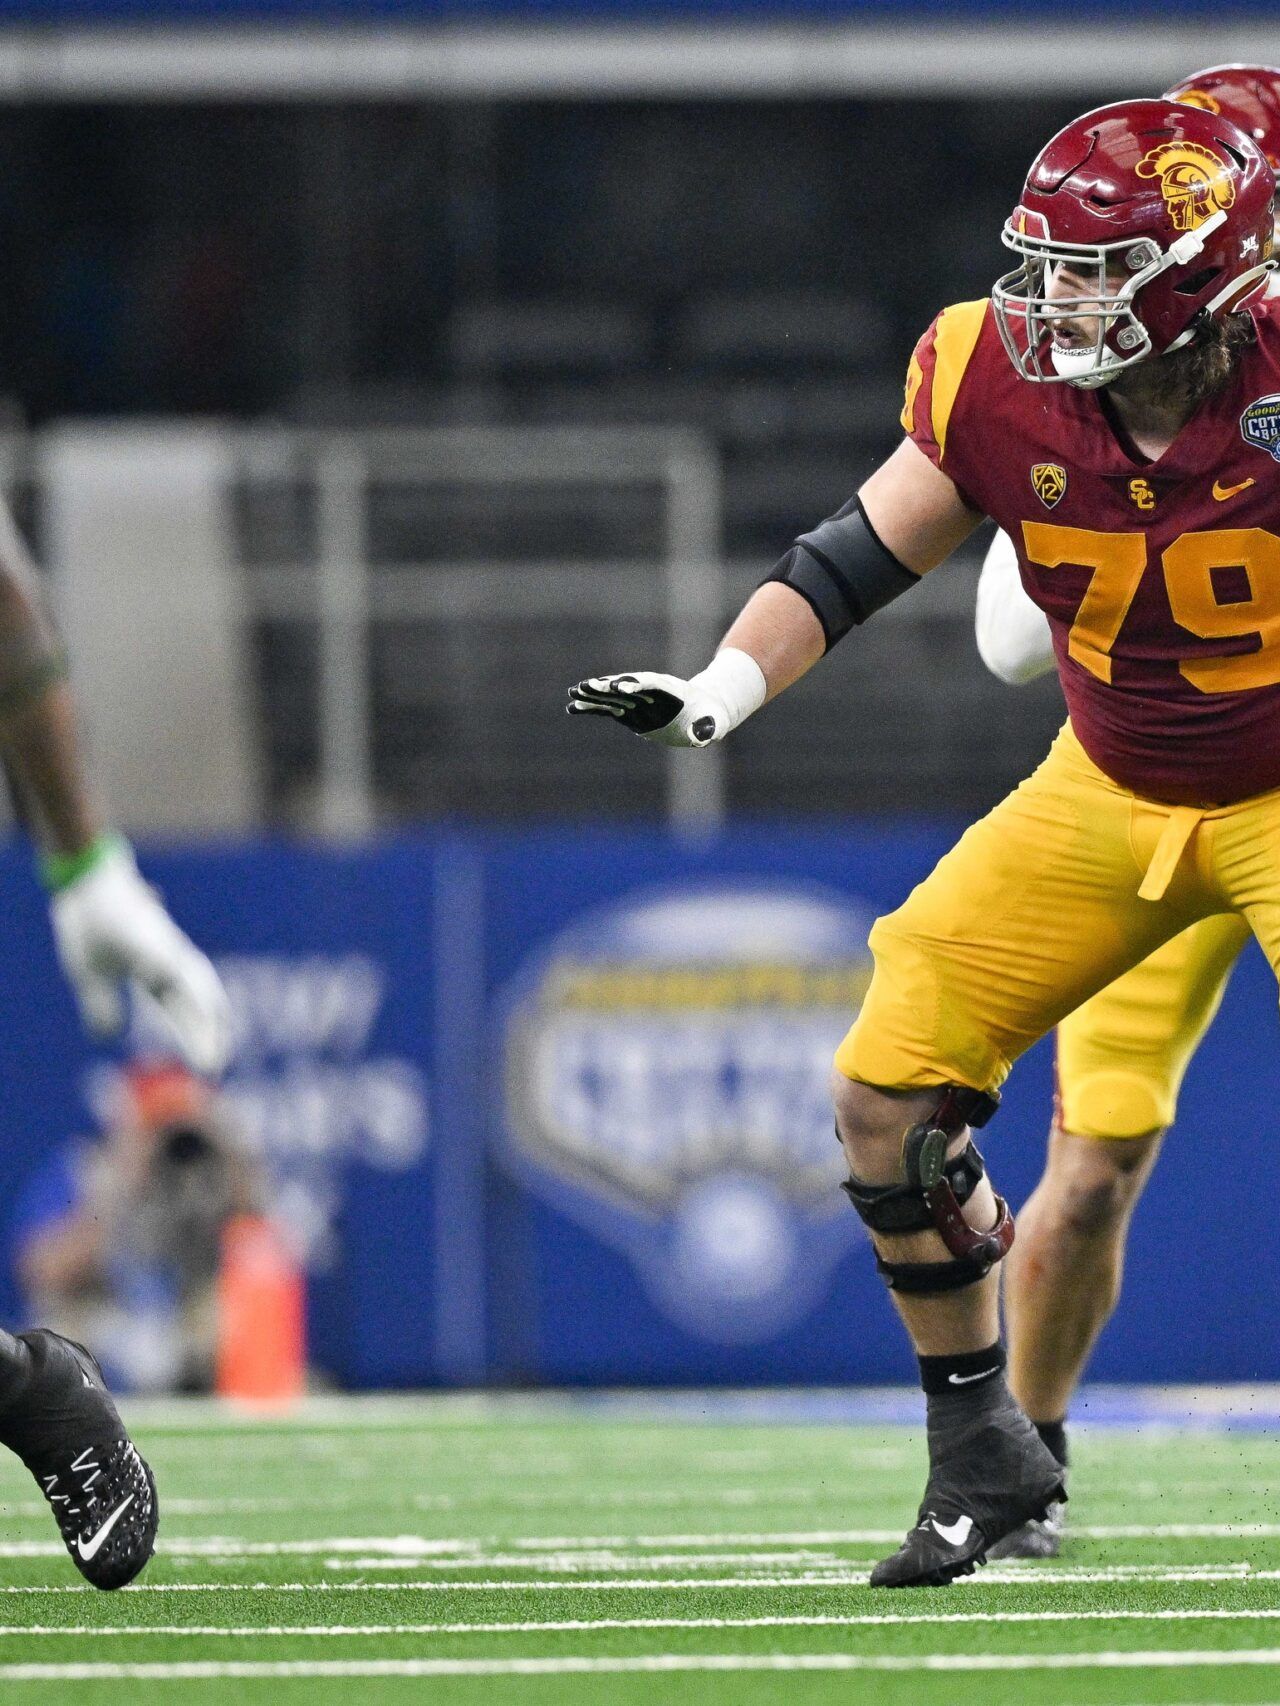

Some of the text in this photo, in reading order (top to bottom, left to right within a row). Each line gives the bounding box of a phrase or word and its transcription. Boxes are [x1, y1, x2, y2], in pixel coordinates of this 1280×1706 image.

[1033, 465, 1064, 492] PAC
[1042, 483, 1058, 500] 12
[1130, 479, 1154, 508] SC
